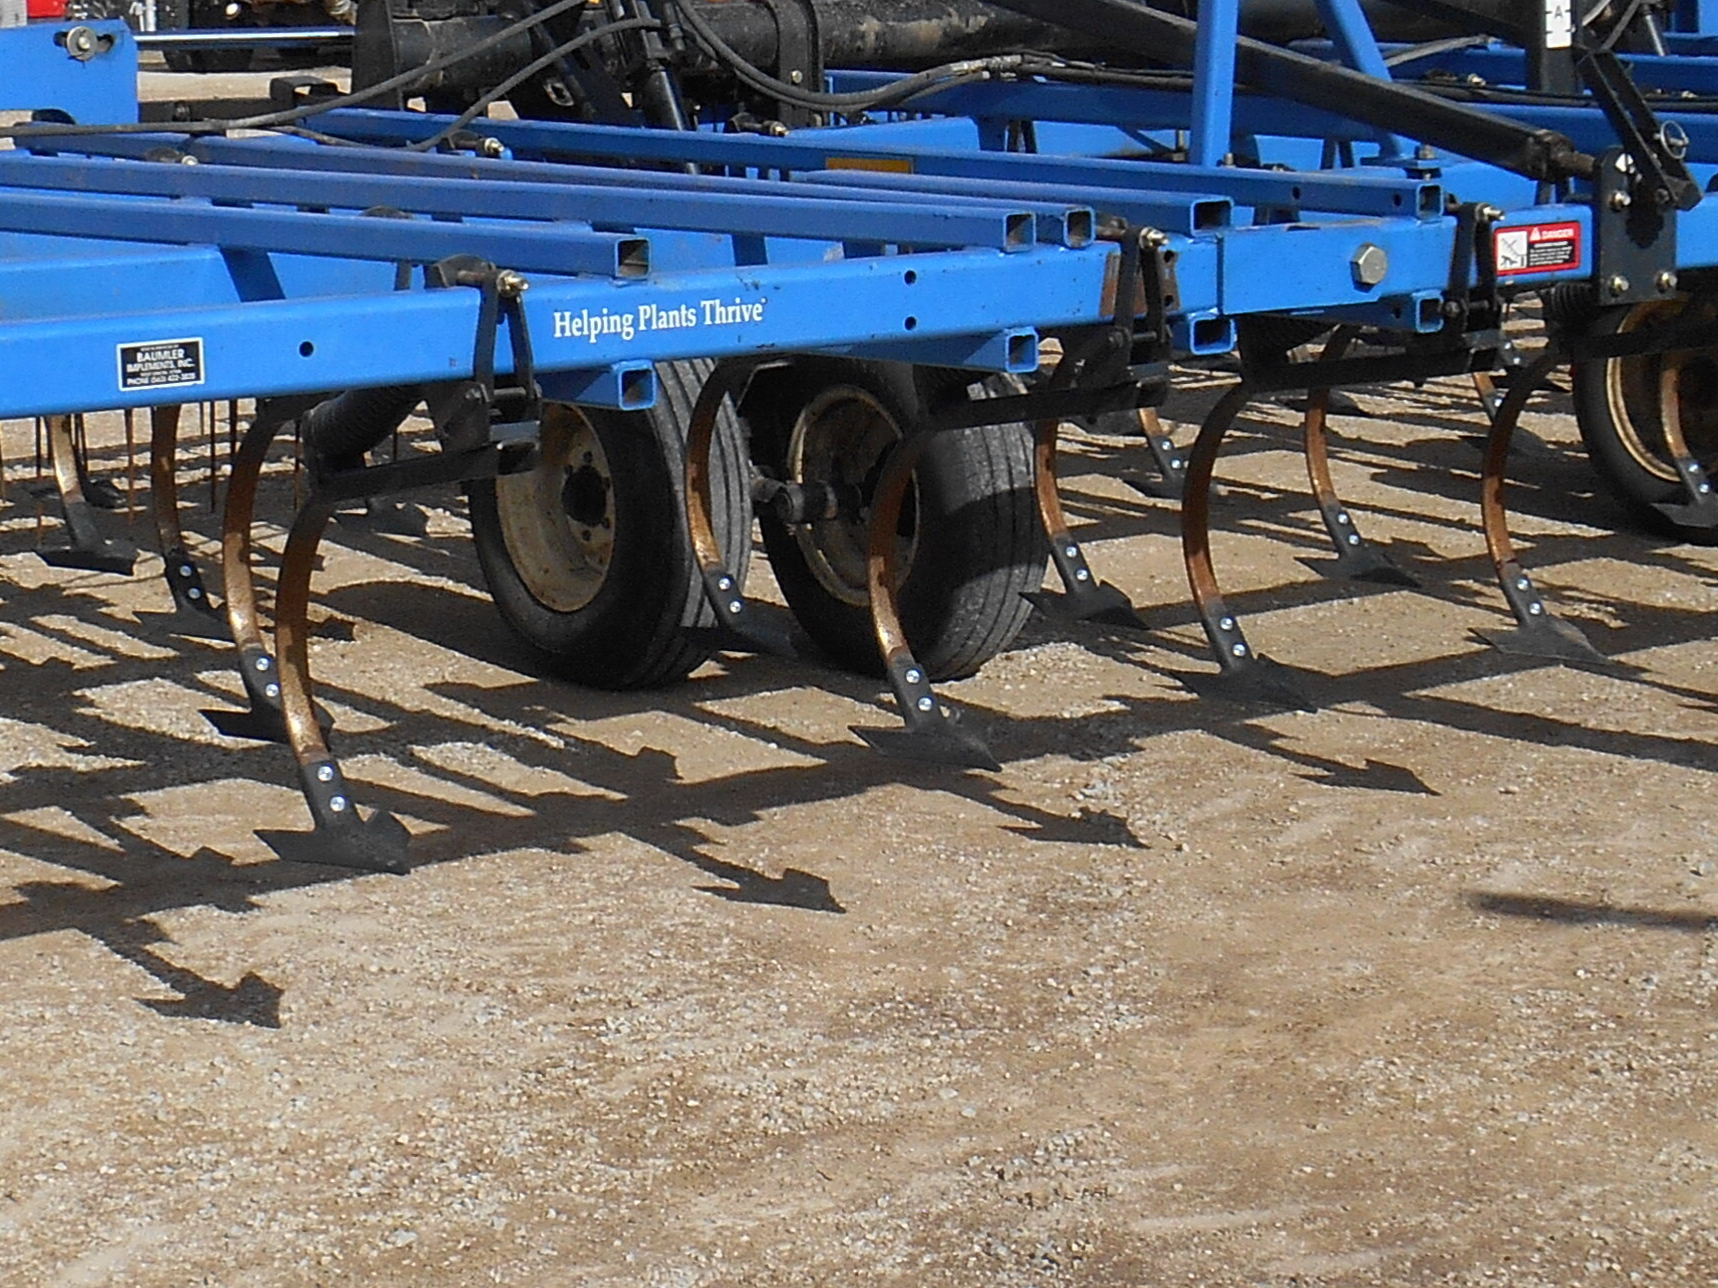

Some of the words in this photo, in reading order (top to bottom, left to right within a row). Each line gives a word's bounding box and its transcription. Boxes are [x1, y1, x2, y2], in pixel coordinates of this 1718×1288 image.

[1554, 6, 1563, 20] A
[553, 307, 634, 343] Helping
[637, 304, 697, 331] Plants
[136, 348, 185, 362] BAUMLER
